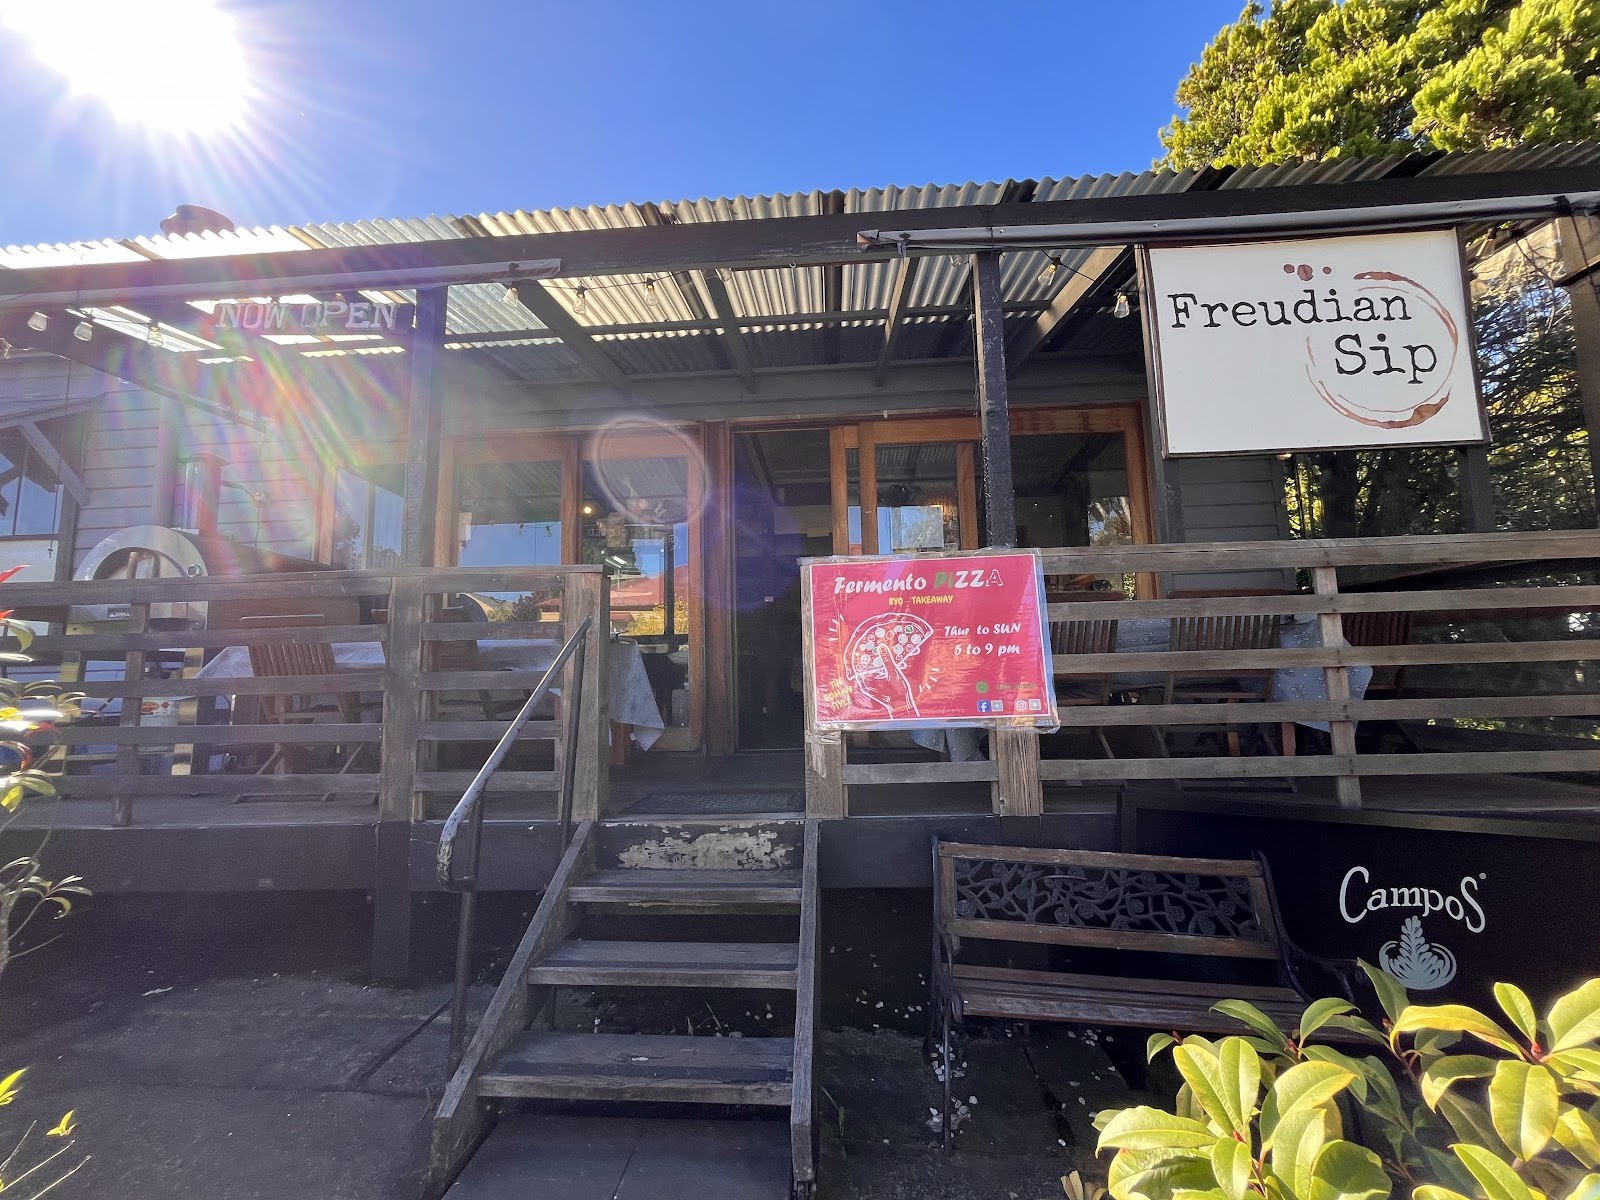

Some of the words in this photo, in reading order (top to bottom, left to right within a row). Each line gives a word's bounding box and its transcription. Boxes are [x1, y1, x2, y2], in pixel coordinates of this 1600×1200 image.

[215, 301, 290, 329] NOW
[301, 301, 394, 330] OPEN
[1167, 288, 1412, 329] Freudian
[1334, 333, 1438, 385] Sip
[834, 573, 927, 594] Fermento
[888, 597, 904, 606] BYO
[912, 595, 953, 605] TAKEAWAY
[944, 625, 970, 637] Thur
[976, 624, 990, 635] to
[993, 622, 1021, 634] SUN
[954, 644, 962, 656] 5
[966, 643, 981, 655] to
[984, 643, 993, 655] 9
[998, 644, 1020, 657] pm
